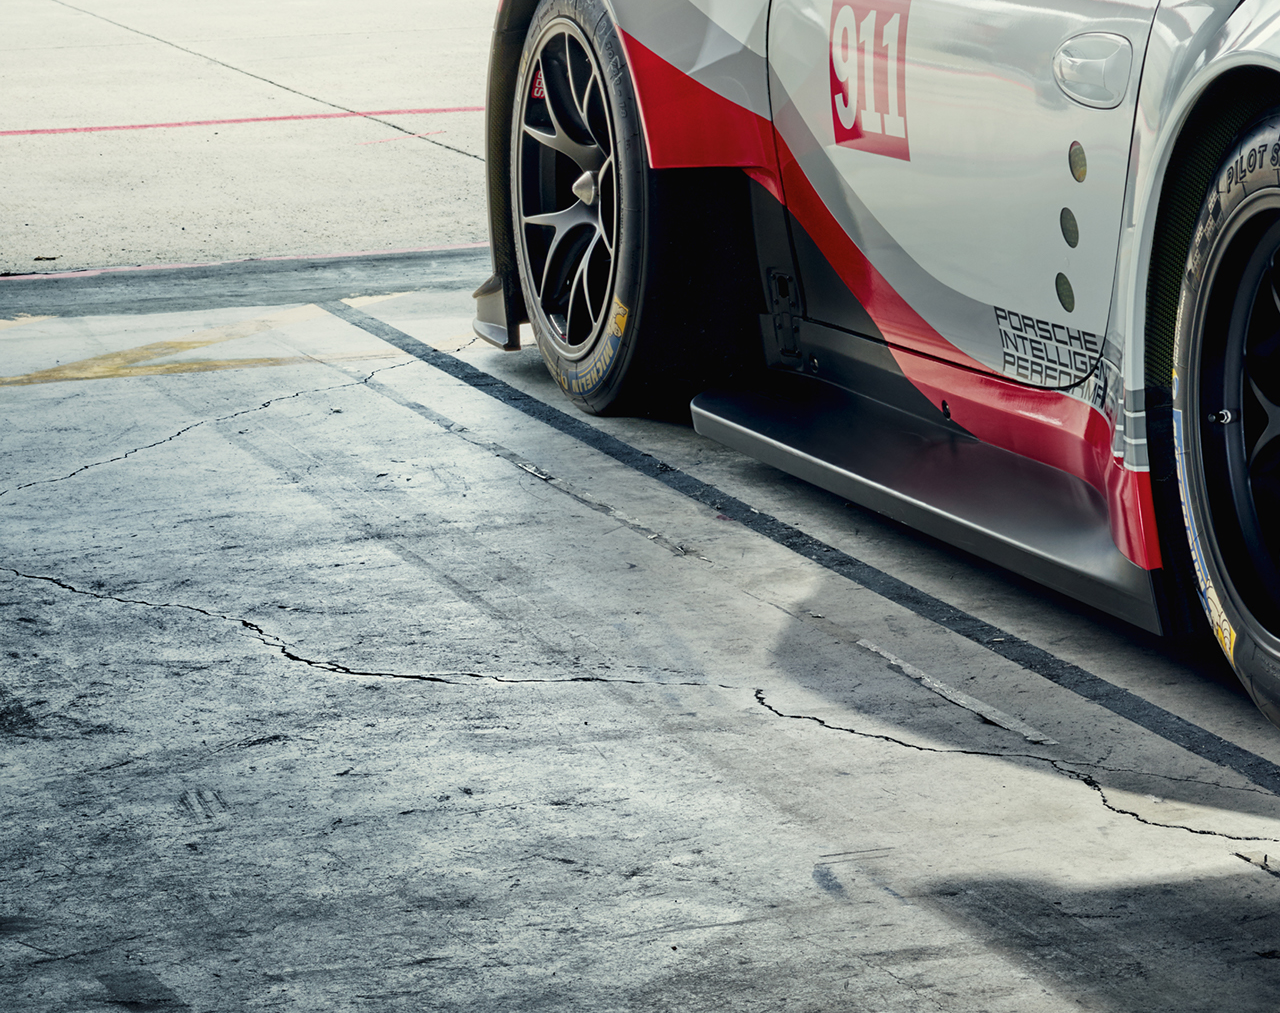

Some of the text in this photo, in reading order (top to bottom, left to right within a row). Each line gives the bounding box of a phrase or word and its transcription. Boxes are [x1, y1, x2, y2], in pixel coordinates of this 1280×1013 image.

[831, 4, 906, 139] 911
[1226, 144, 1268, 194] PILOT
[993, 305, 1100, 354] PORSCHE
[572, 340, 614, 393] MICHELIN
